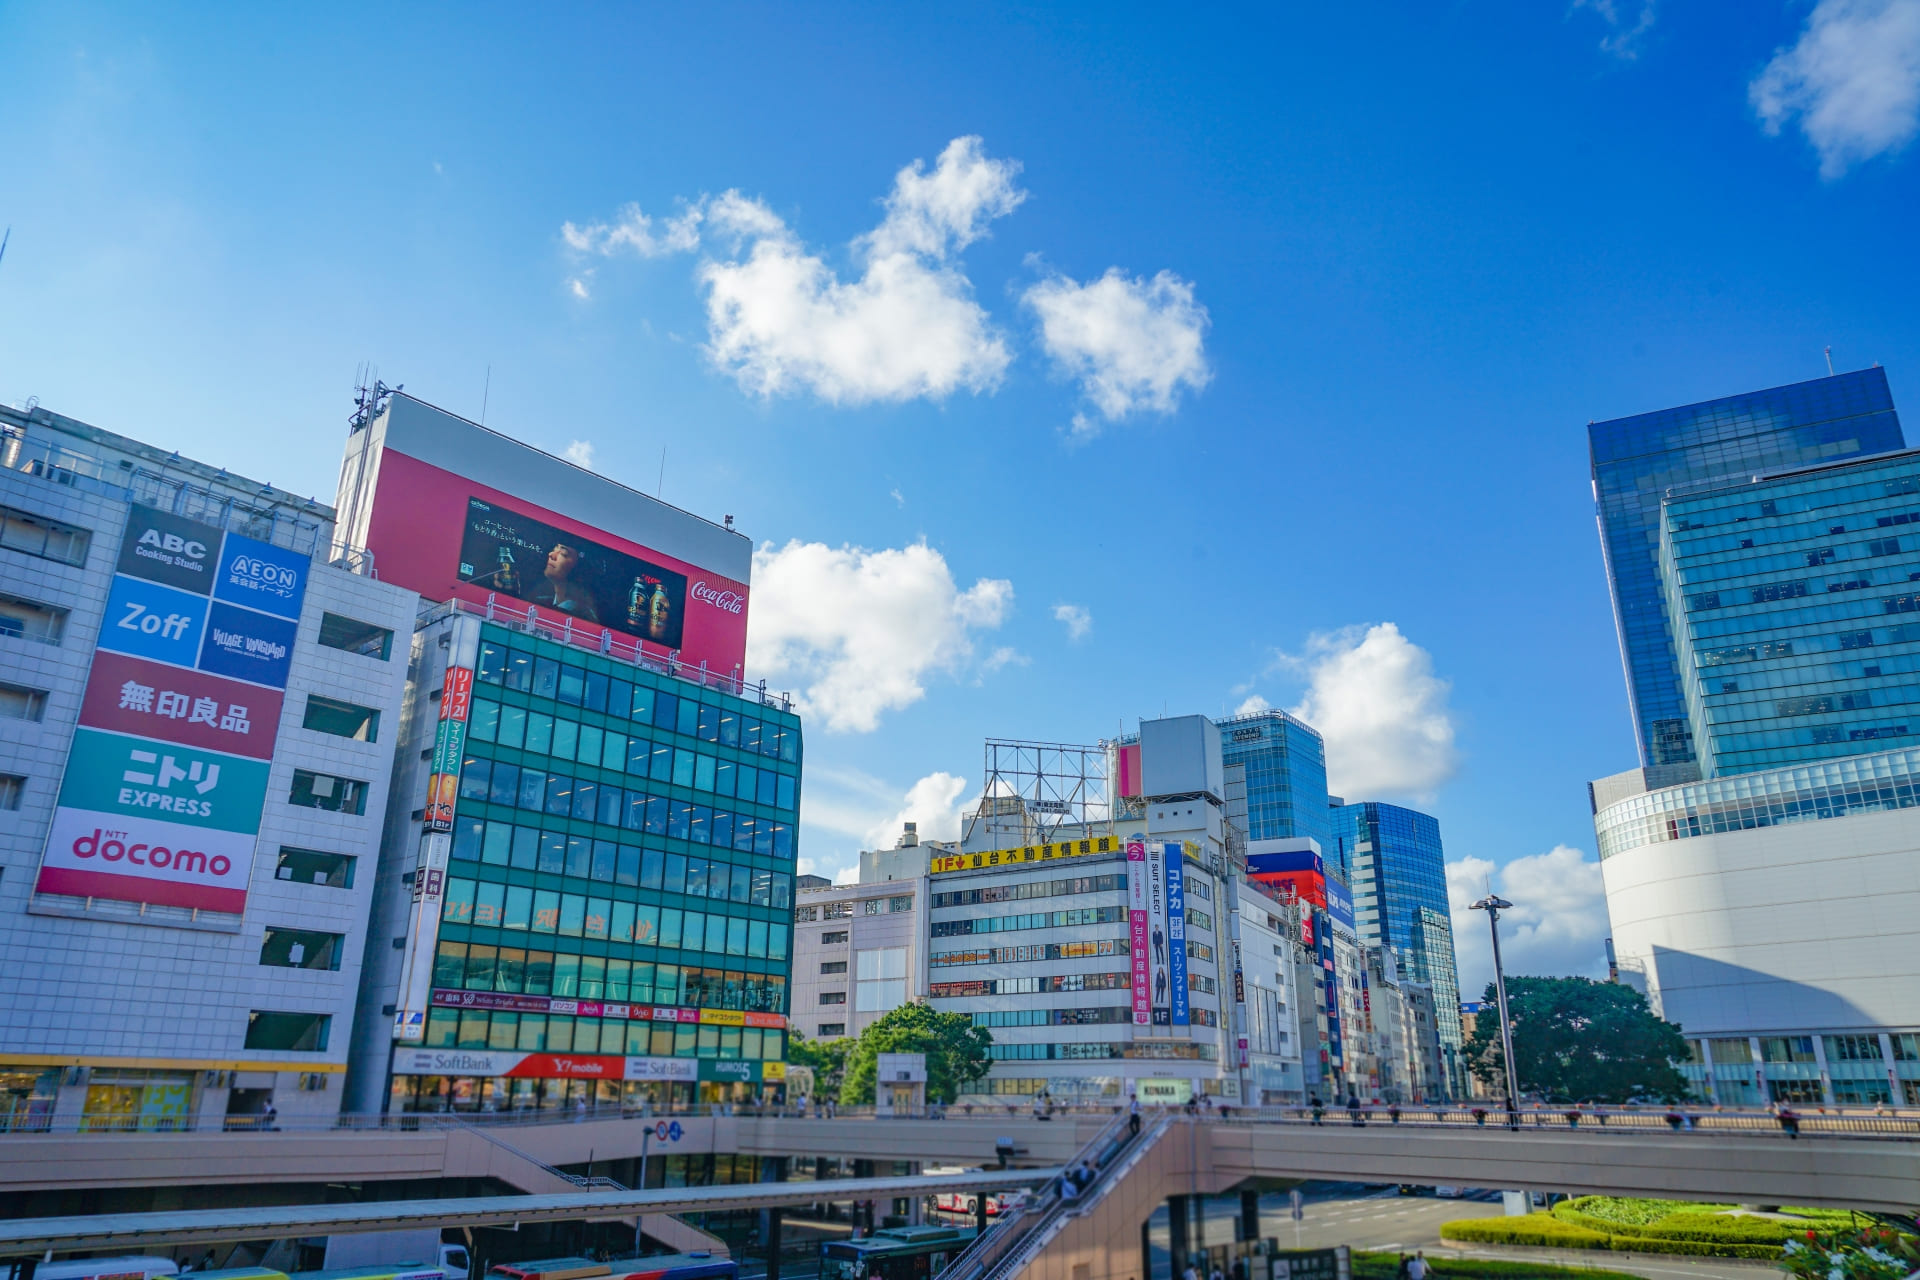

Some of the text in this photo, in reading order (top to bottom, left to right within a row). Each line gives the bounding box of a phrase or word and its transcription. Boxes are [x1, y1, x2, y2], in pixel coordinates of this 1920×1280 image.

[138, 528, 207, 558] ABC
[136, 546, 203, 571] Cooking Studio
[233, 556, 295, 588] AEON
[230, 575, 294, 598] 英会話イーオン
[118, 602, 191, 640] Zoff
[213, 628, 243, 648] VILLAGE
[246, 637, 286, 659] VANGUARD
[119, 679, 250, 734] 無印良品
[123, 749, 220, 795] ニトリ
[118, 787, 212, 817] EXPRESS
[104, 829, 128, 840] NTT
[72, 828, 231, 876] docomo
[936, 857, 954, 872] 1F
[973, 837, 1109, 867] 仙台不動産情報館
[1151, 863, 1161, 915] SUIT SELECT
[1168, 869, 1181, 909] コナカ
[1172, 918, 1181, 927] 3F
[1172, 929, 1182, 937] 2F
[1133, 912, 1147, 1011] 仙台不動産情報館
[1173, 946, 1185, 1016] スーツ・フォーマル
[1154, 1012, 1168, 1022] 1F
[435, 1053, 493, 1070] SoftBank
[649, 1061, 691, 1076] SoftBank
[1143, 1085, 1176, 1097] KONAKA
